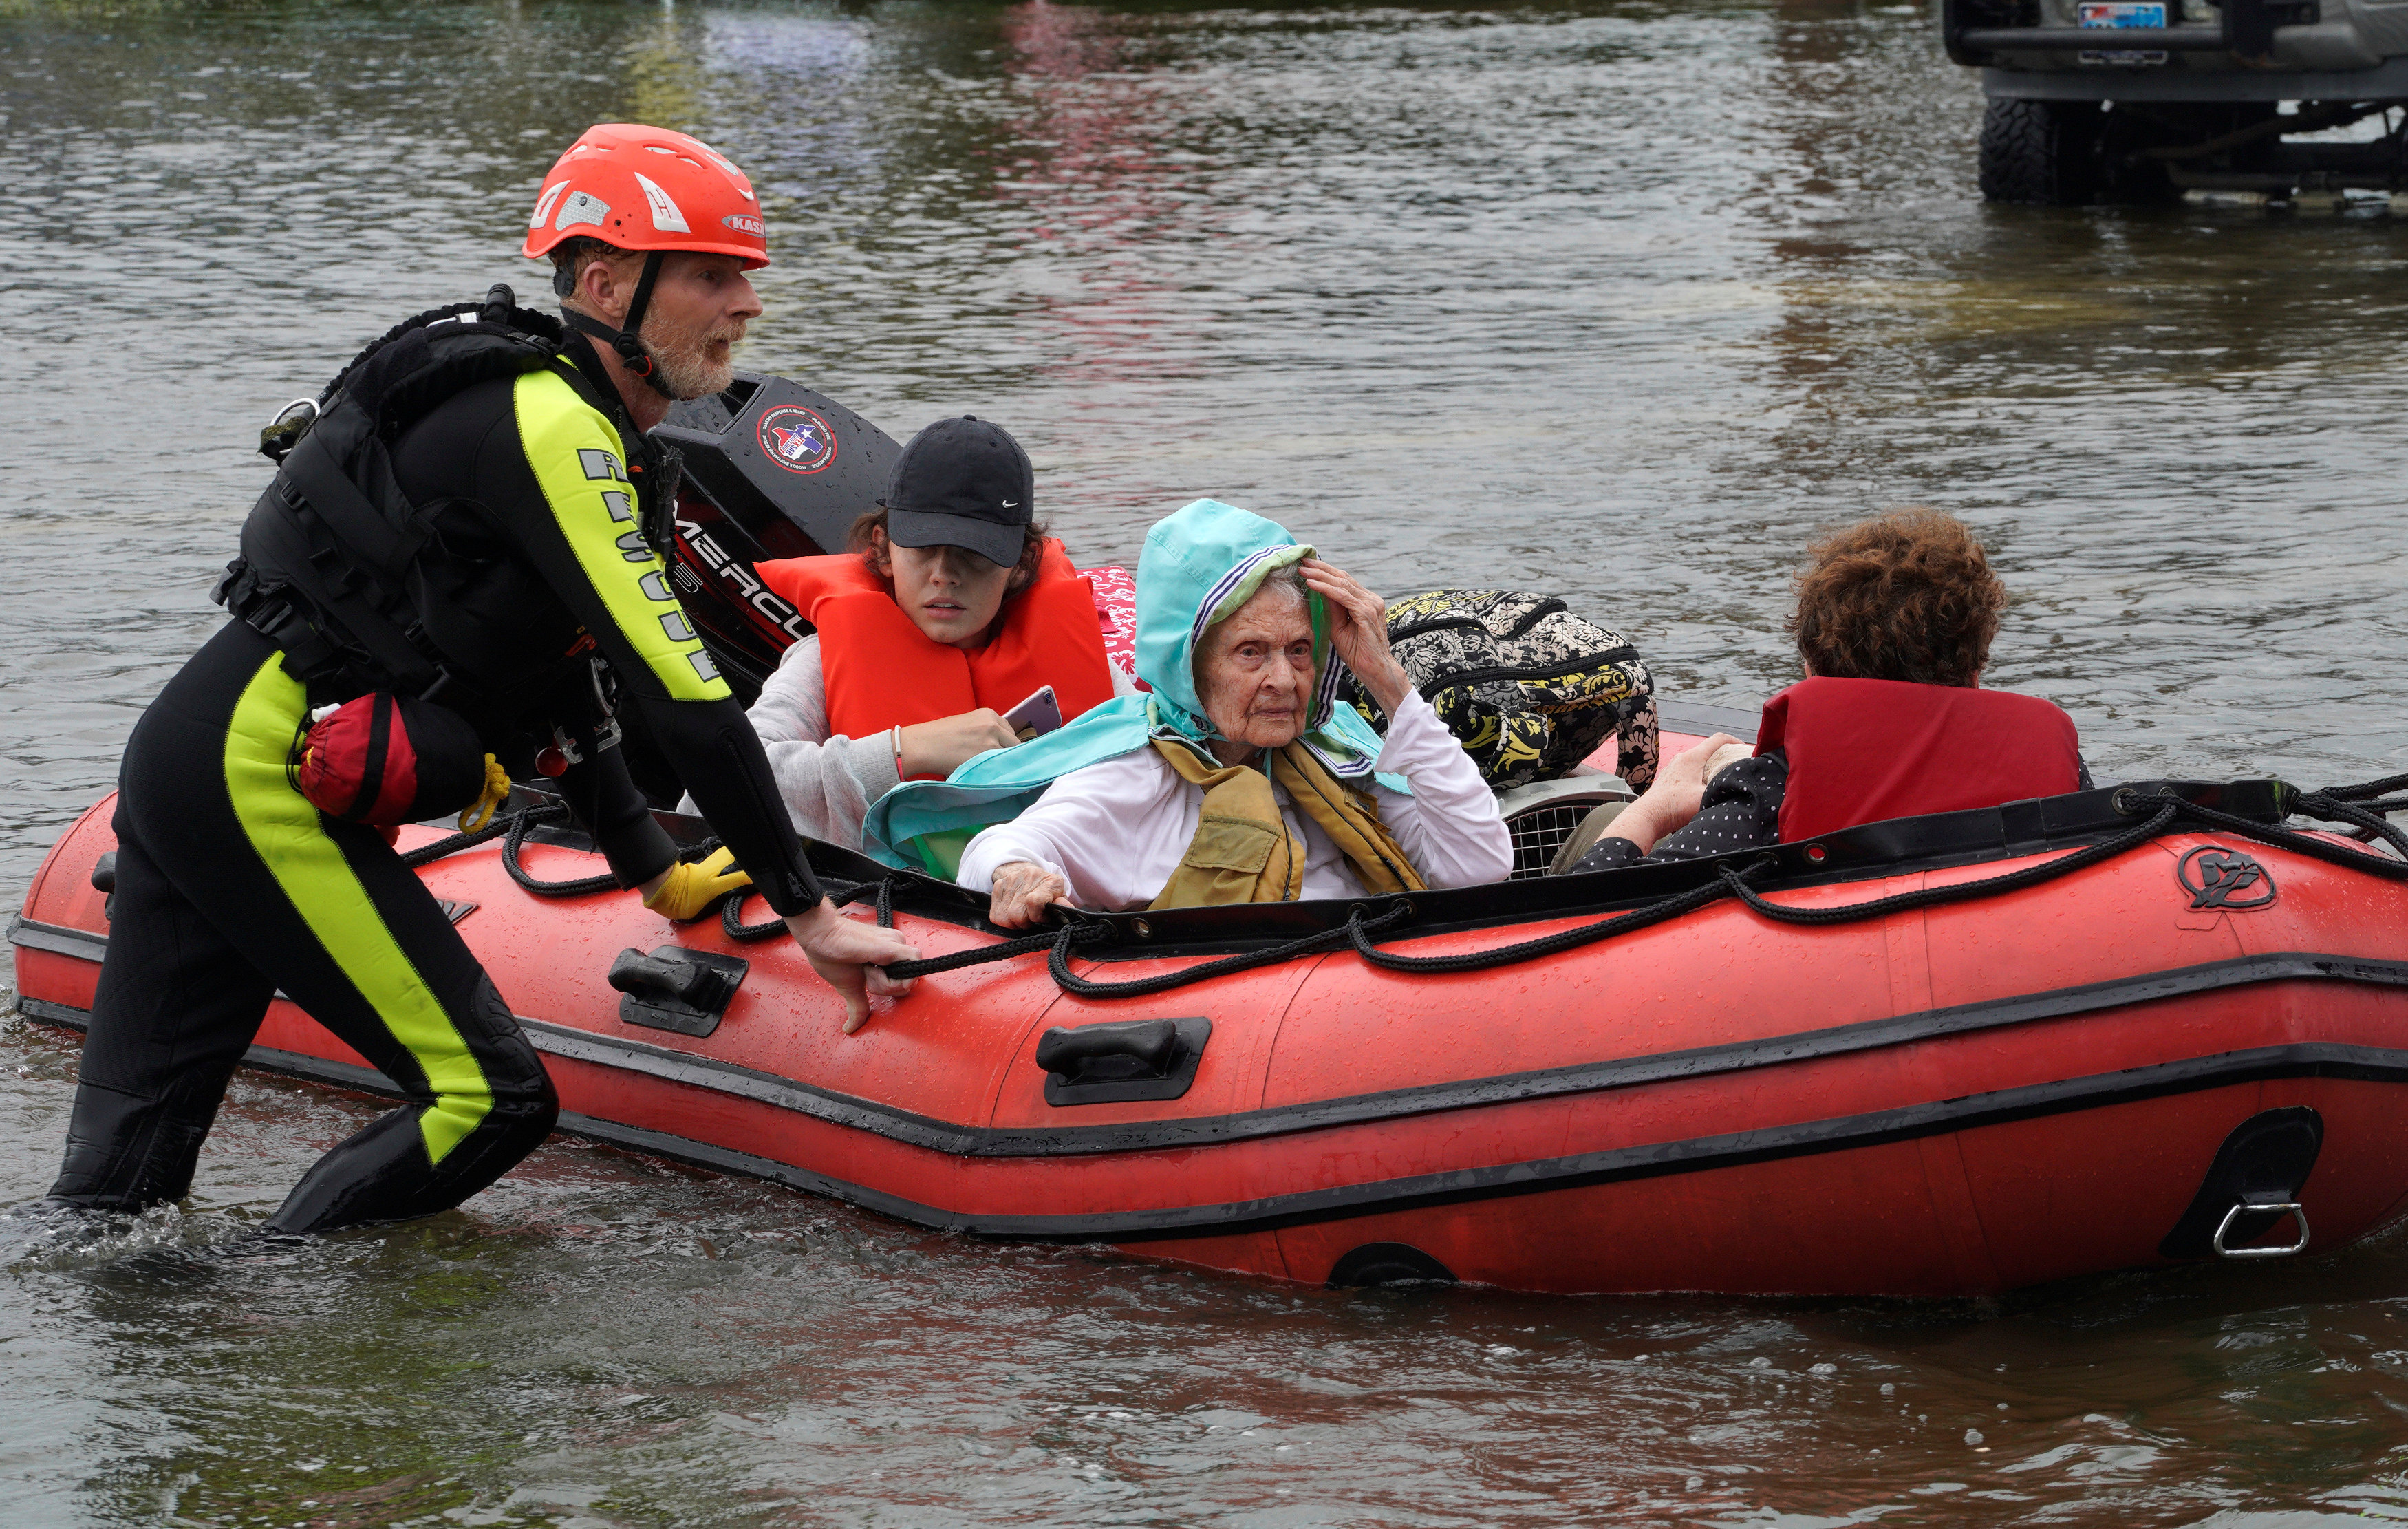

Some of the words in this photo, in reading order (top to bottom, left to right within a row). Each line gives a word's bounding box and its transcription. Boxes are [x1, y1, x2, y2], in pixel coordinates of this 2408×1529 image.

[785, 436, 805, 456] TEXSAR
[577, 448, 720, 683] RESCUE
[674, 498, 804, 640] MERCU
